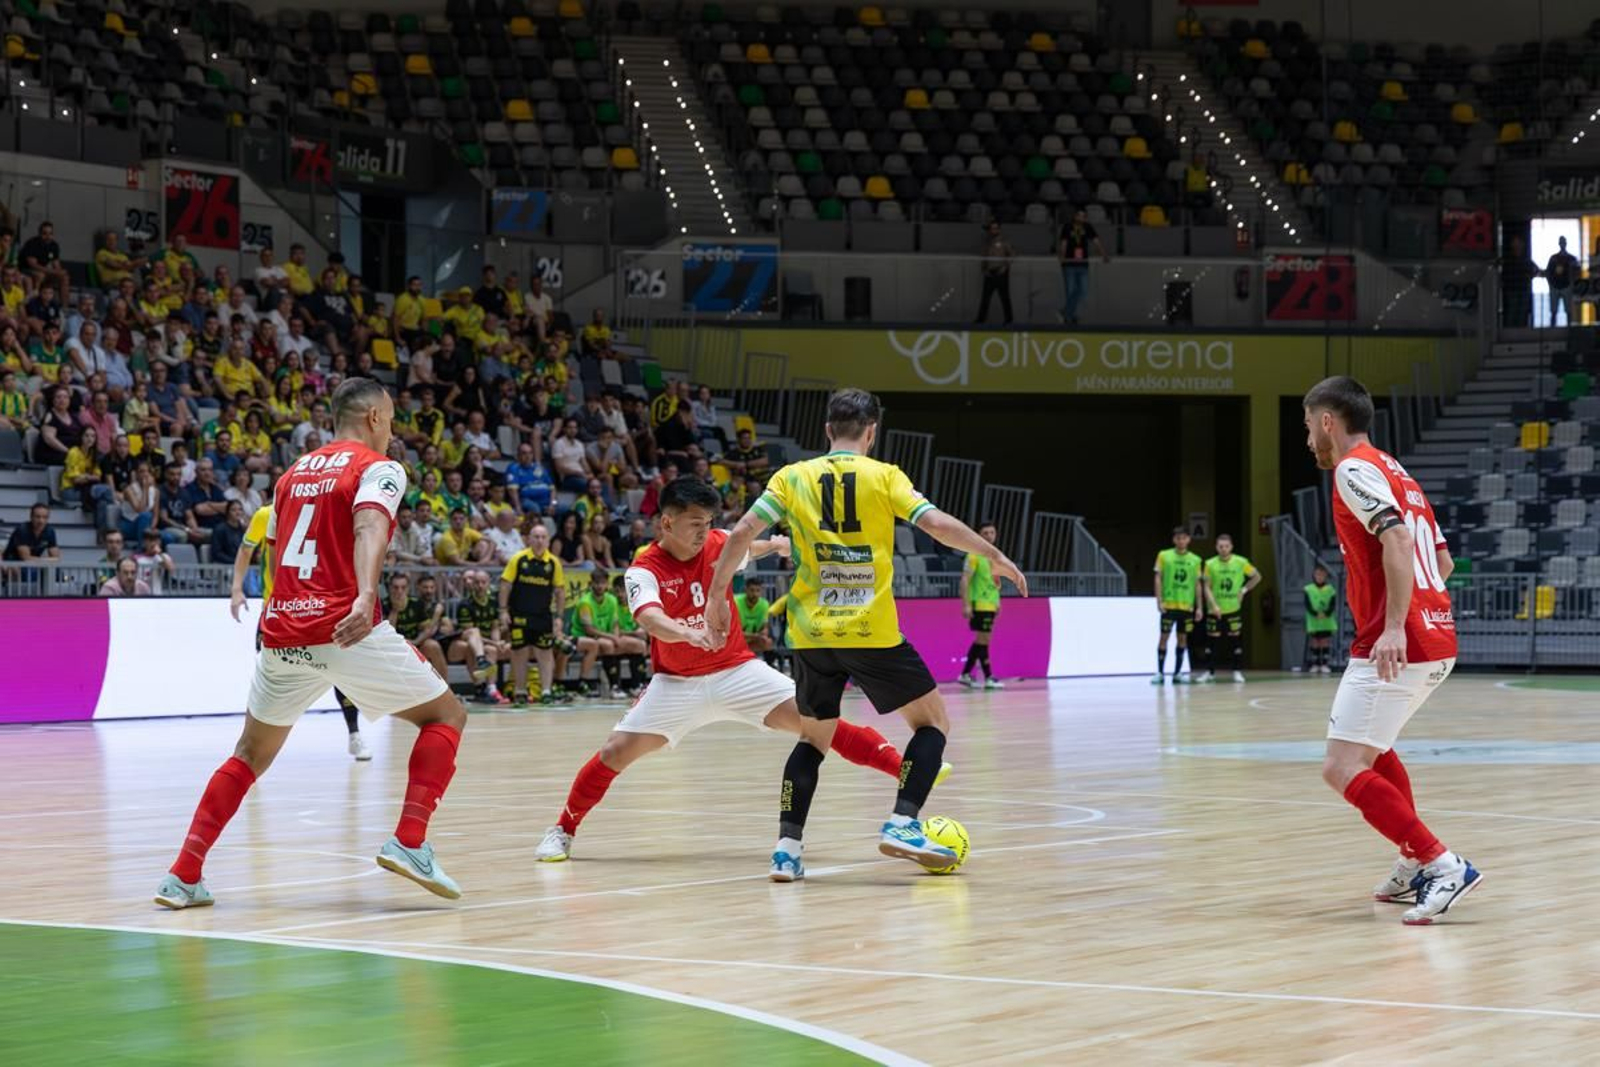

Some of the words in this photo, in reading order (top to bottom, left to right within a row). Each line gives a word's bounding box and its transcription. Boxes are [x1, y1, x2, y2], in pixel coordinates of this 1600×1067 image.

[336, 144, 382, 172] alida
[384, 137, 407, 176] 11
[164, 166, 214, 192] Sector
[1536, 175, 1600, 202] Salid
[126, 209, 159, 243] 25
[166, 170, 239, 250] 26
[242, 222, 273, 247] 25
[682, 244, 745, 262] Sector
[1265, 254, 1323, 271] Sector
[536, 257, 563, 289] 26
[627, 268, 667, 299] 26
[682, 245, 777, 312] 27
[1266, 255, 1357, 320] 28
[980, 332, 1086, 368] olivo
[1099, 339, 1234, 370] arena
[294, 451, 355, 472] 2015
[817, 472, 863, 534] 11
[281, 503, 319, 580] 4
[1402, 509, 1446, 593] 10
[270, 595, 327, 612] Lusíadas
[690, 581, 705, 608] 8
